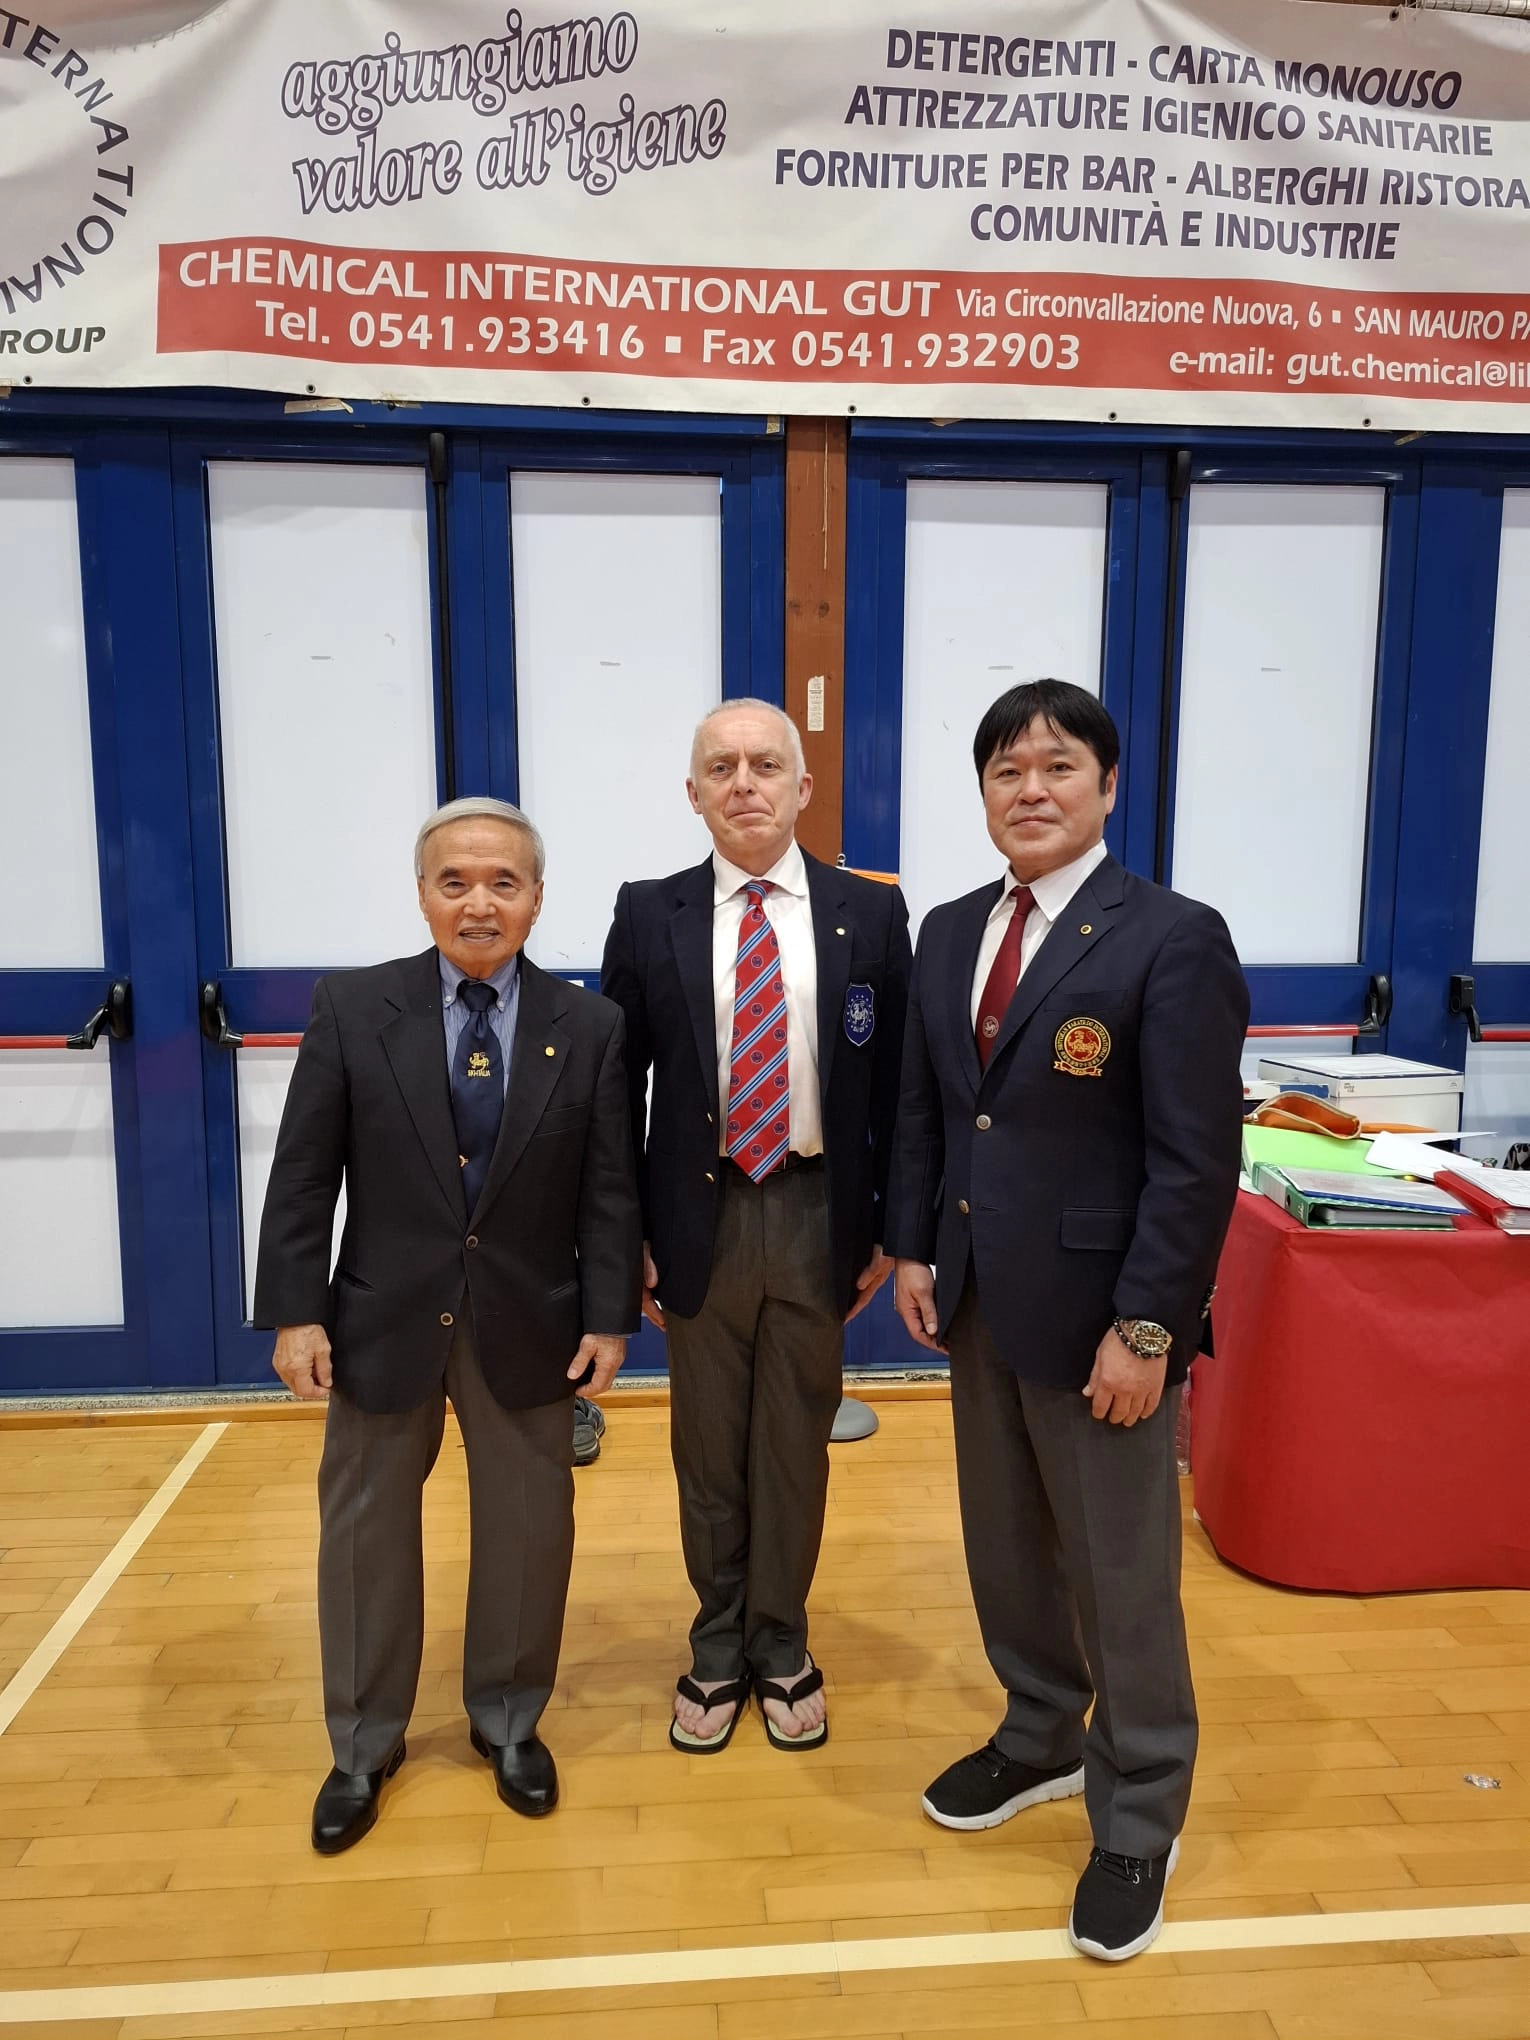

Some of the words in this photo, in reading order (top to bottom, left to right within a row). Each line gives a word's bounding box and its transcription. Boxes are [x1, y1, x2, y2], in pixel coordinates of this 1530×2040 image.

[281, 8, 638, 135] aggiungiamo
[886, 28, 1117, 78] DETERGENTI
[1128, 60, 1138, 68] -
[1149, 45, 1265, 87] CARTA
[1274, 60, 1462, 110] MONOUSO
[292, 127, 463, 215] valore
[476, 93, 727, 195] all'igiene
[844, 85, 1130, 131] ATTREZZATURE
[1142, 96, 1305, 141] IGIENICO
[1318, 110, 1493, 156] SANITARIE
[775, 149, 988, 189] FORNITURE
[1001, 152, 1069, 190] PER
[1082, 155, 1156, 194] BAR
[1167, 176, 1177, 184] -
[1185, 160, 1369, 206] ALBERGHI
[1380, 168, 1530, 209] RISTORA
[970, 201, 1168, 247] COMUNITÀ
[1180, 211, 1202, 246] E
[1214, 212, 1400, 260] INDUSTRIE
[179, 247, 428, 299] CHEMICAL
[445, 263, 828, 315] INTERNATIONAL
[843, 279, 940, 317] GUT
[956, 288, 996, 317] Via
[1005, 288, 1205, 324] Circonvallazione
[1212, 296, 1299, 330] Nuova,
[1308, 302, 1322, 328] 6
[1354, 306, 1400, 336] SAN
[1408, 309, 1504, 340] MAURO
[0, 326, 106, 354] ROUP
[255, 300, 330, 344] Tel.
[348, 311, 644, 360] 0541.933416
[703, 329, 775, 366] Fax
[791, 330, 1080, 370] 0541.932903
[1169, 346, 1274, 376] e-mail:
